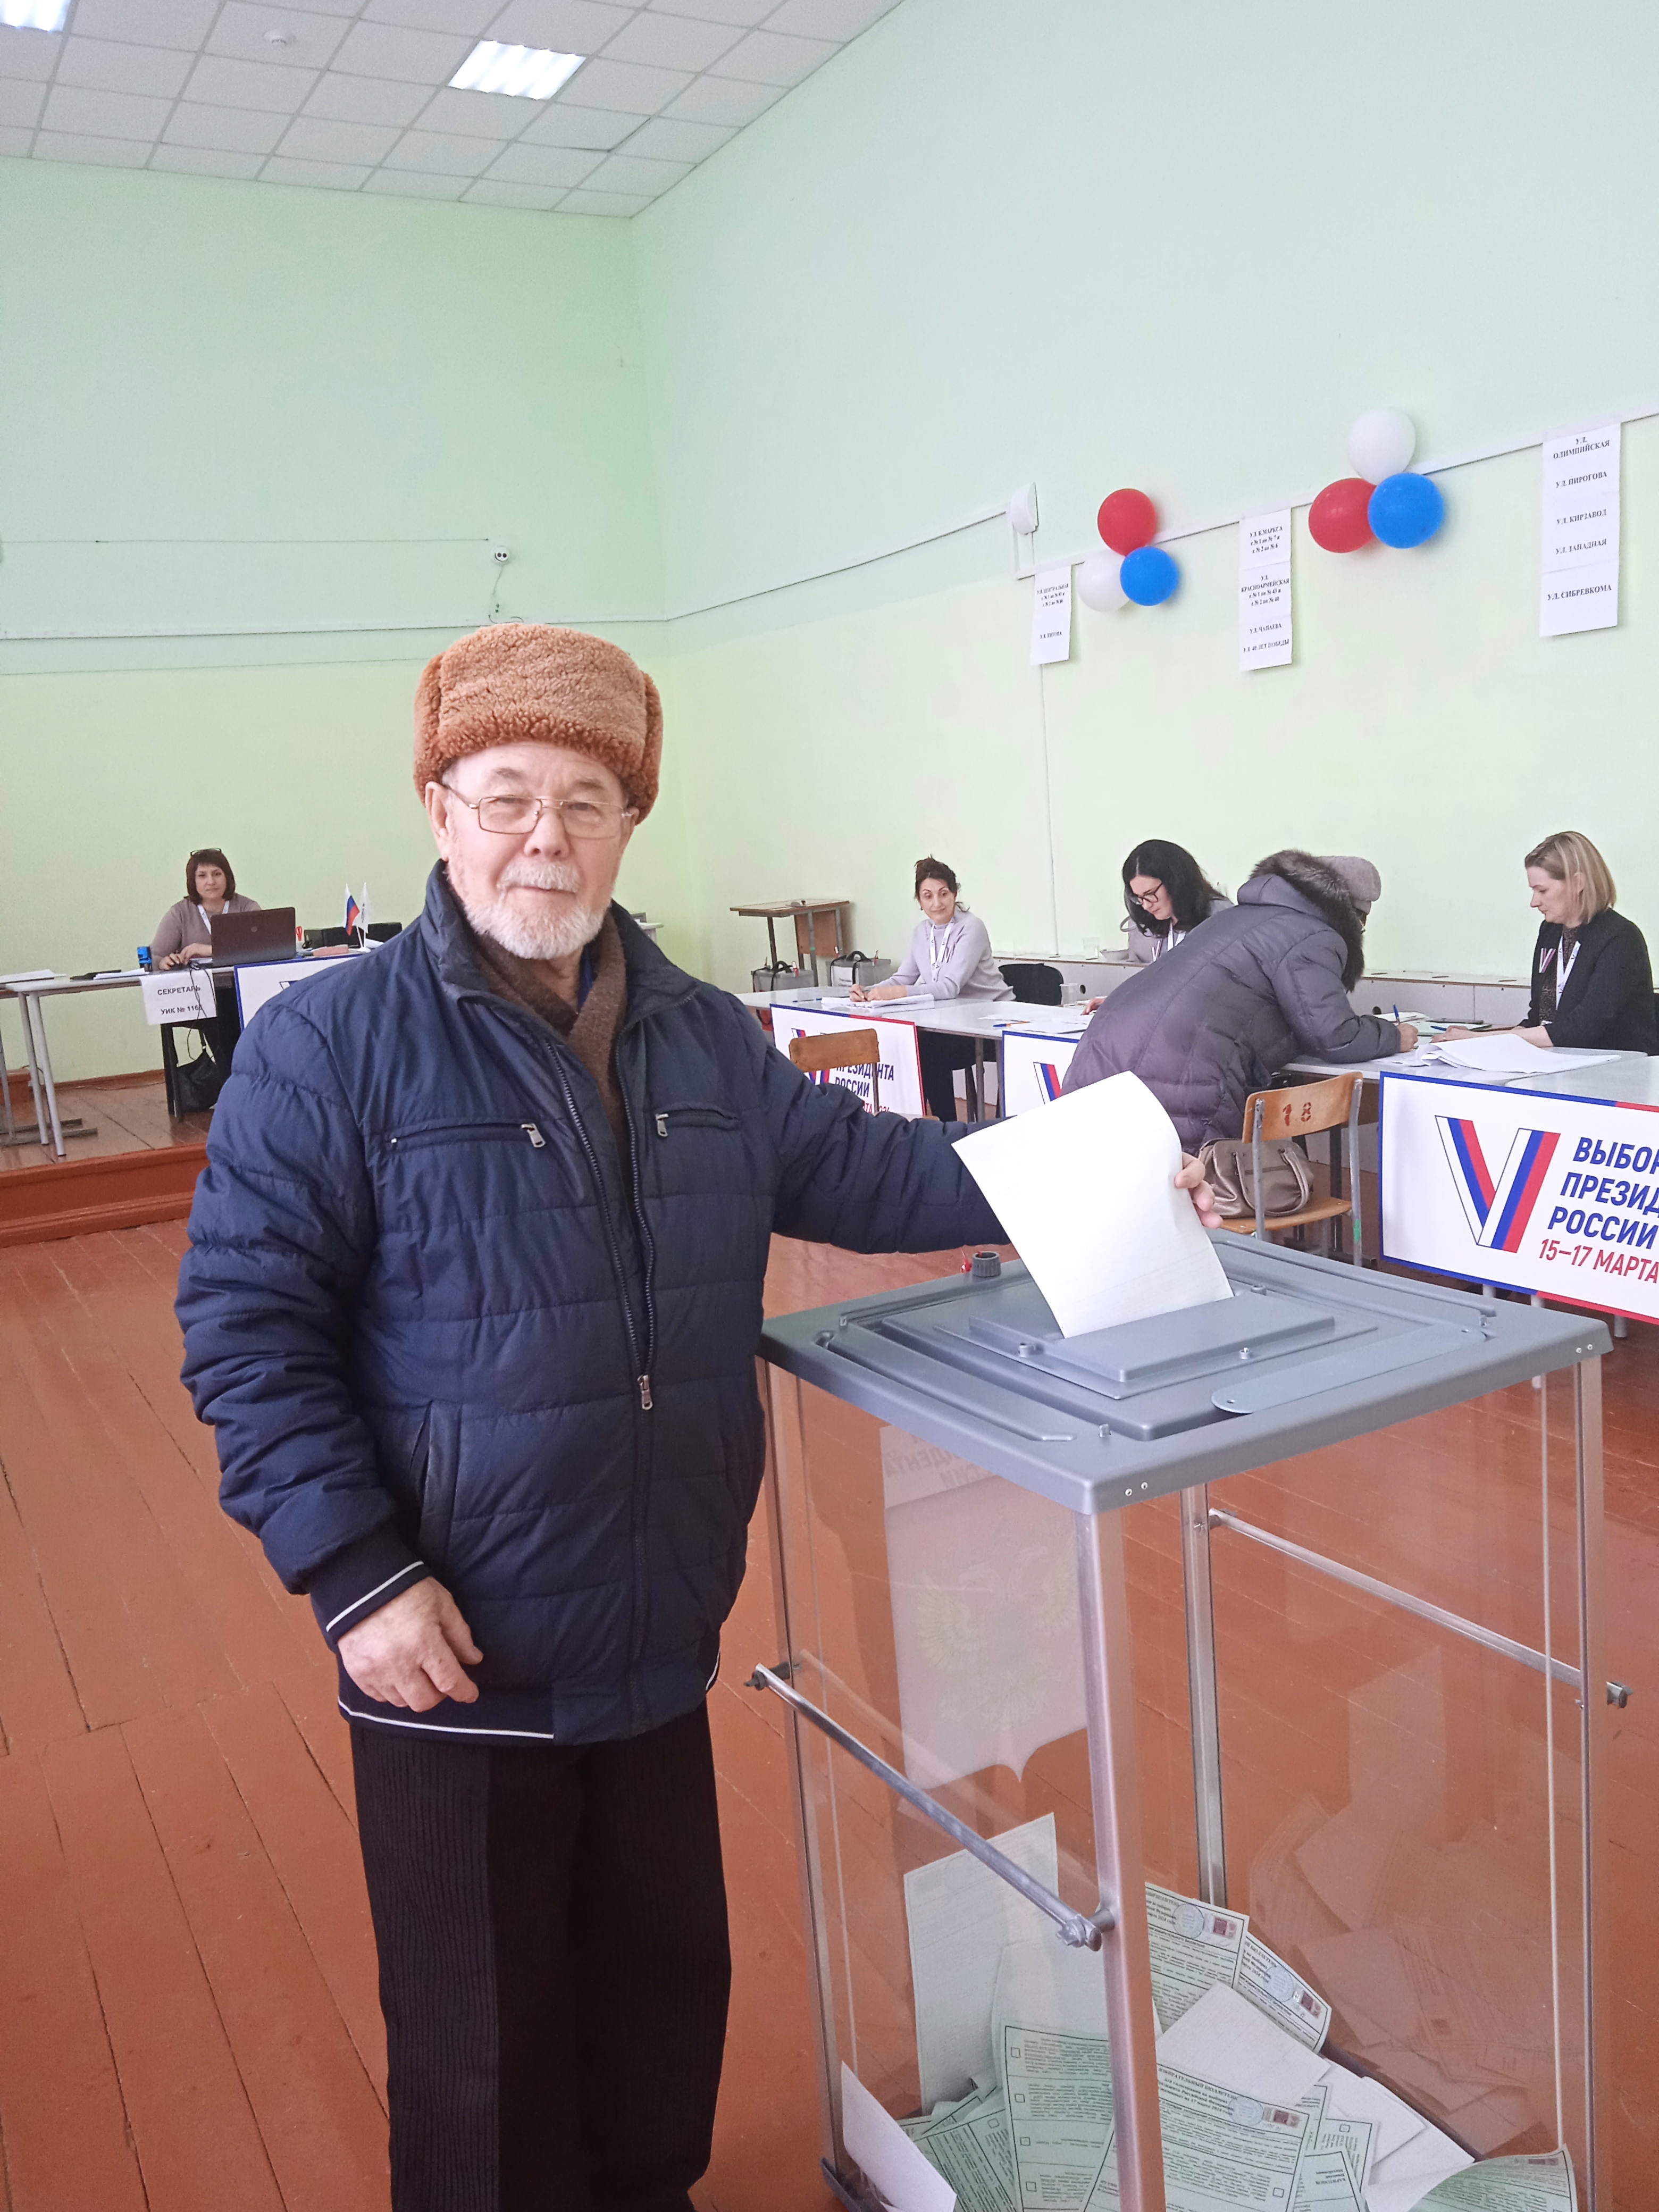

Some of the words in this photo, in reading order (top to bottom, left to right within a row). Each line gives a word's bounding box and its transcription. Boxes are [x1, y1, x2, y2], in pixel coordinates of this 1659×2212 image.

[1553, 440, 1610, 459] ОЛИМПИЙСКАЯ
[1569, 471, 1607, 485] ПИРОГОВА
[1569, 509, 1607, 523] КИРЗАВОД
[1569, 539, 1607, 552] ЗАПАДНАЯ
[1241, 578, 1289, 592] КРАСНОАРМЕЙСКАЯ
[1561, 584, 1612, 599] СИБРЕВКОМА
[1259, 623, 1281, 632] ЧАПАЕВА
[1268, 639, 1289, 648] ПОБЕДЫ
[157, 985, 200, 995] СЕКРЕТАРЬ
[836, 1063, 894, 1080] ЕЗИДНТА
[1547, 1206, 1659, 1250] РОССИИ
[1593, 1249, 1659, 1284] МАРТА
